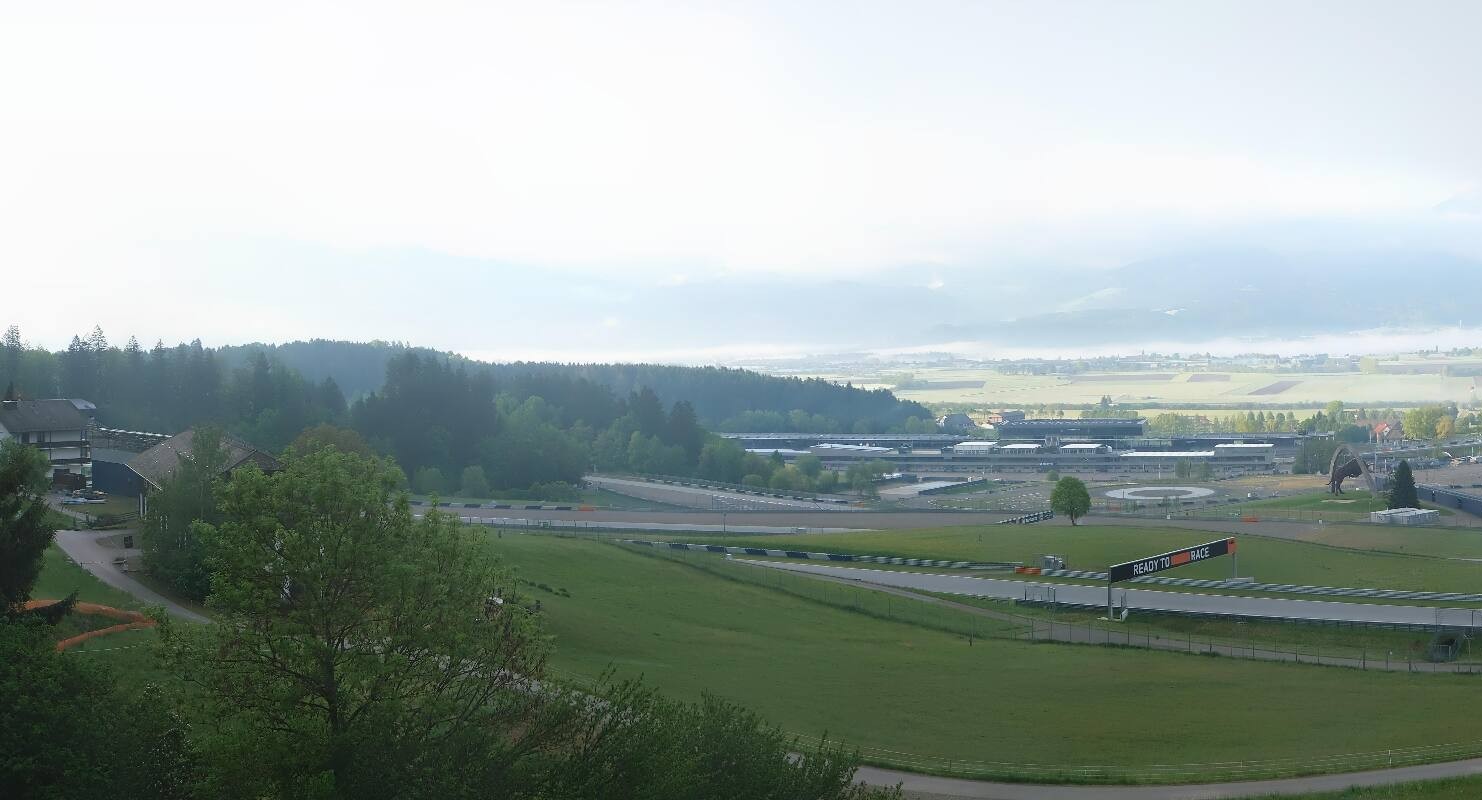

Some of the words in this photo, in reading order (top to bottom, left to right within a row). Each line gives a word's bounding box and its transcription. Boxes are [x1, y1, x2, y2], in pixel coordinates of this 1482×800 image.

[1133, 561, 1159, 575] READY
[1160, 556, 1170, 569] TO
[1190, 547, 1210, 561] RACE
